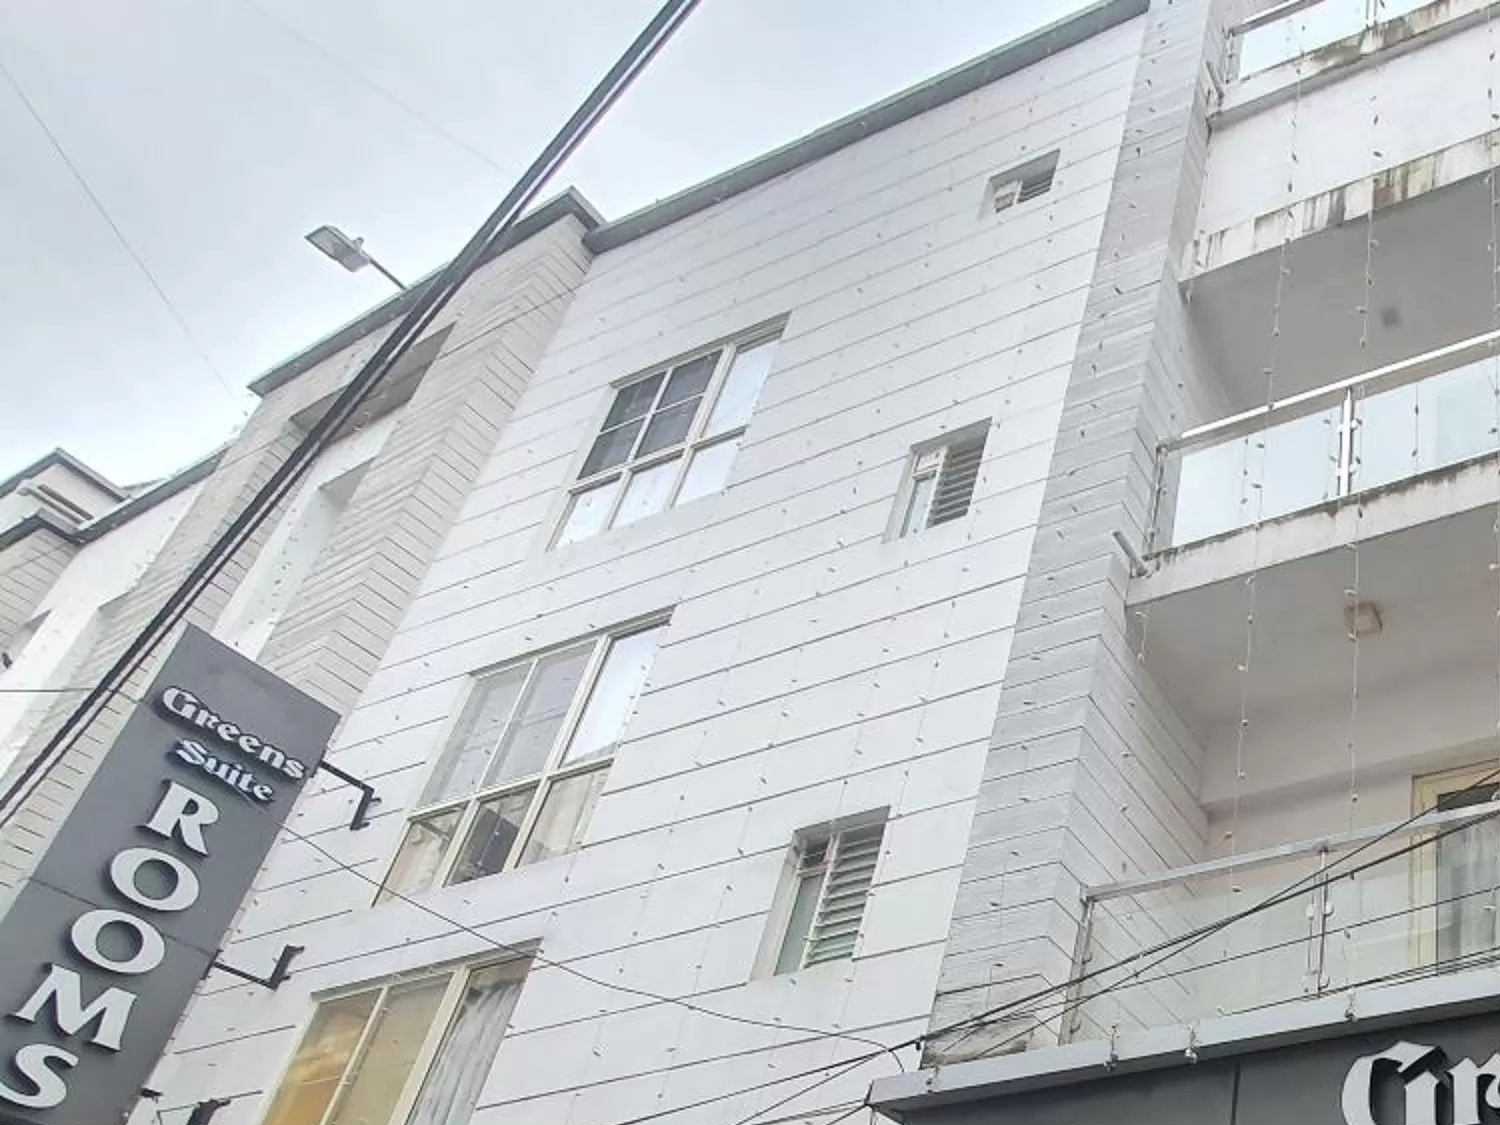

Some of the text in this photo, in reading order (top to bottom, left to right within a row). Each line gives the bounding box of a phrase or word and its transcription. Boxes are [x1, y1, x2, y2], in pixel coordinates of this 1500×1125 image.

[162, 686, 307, 780] Greens
[176, 739, 275, 801] Suite
[0, 781, 220, 1109] ROOMS
